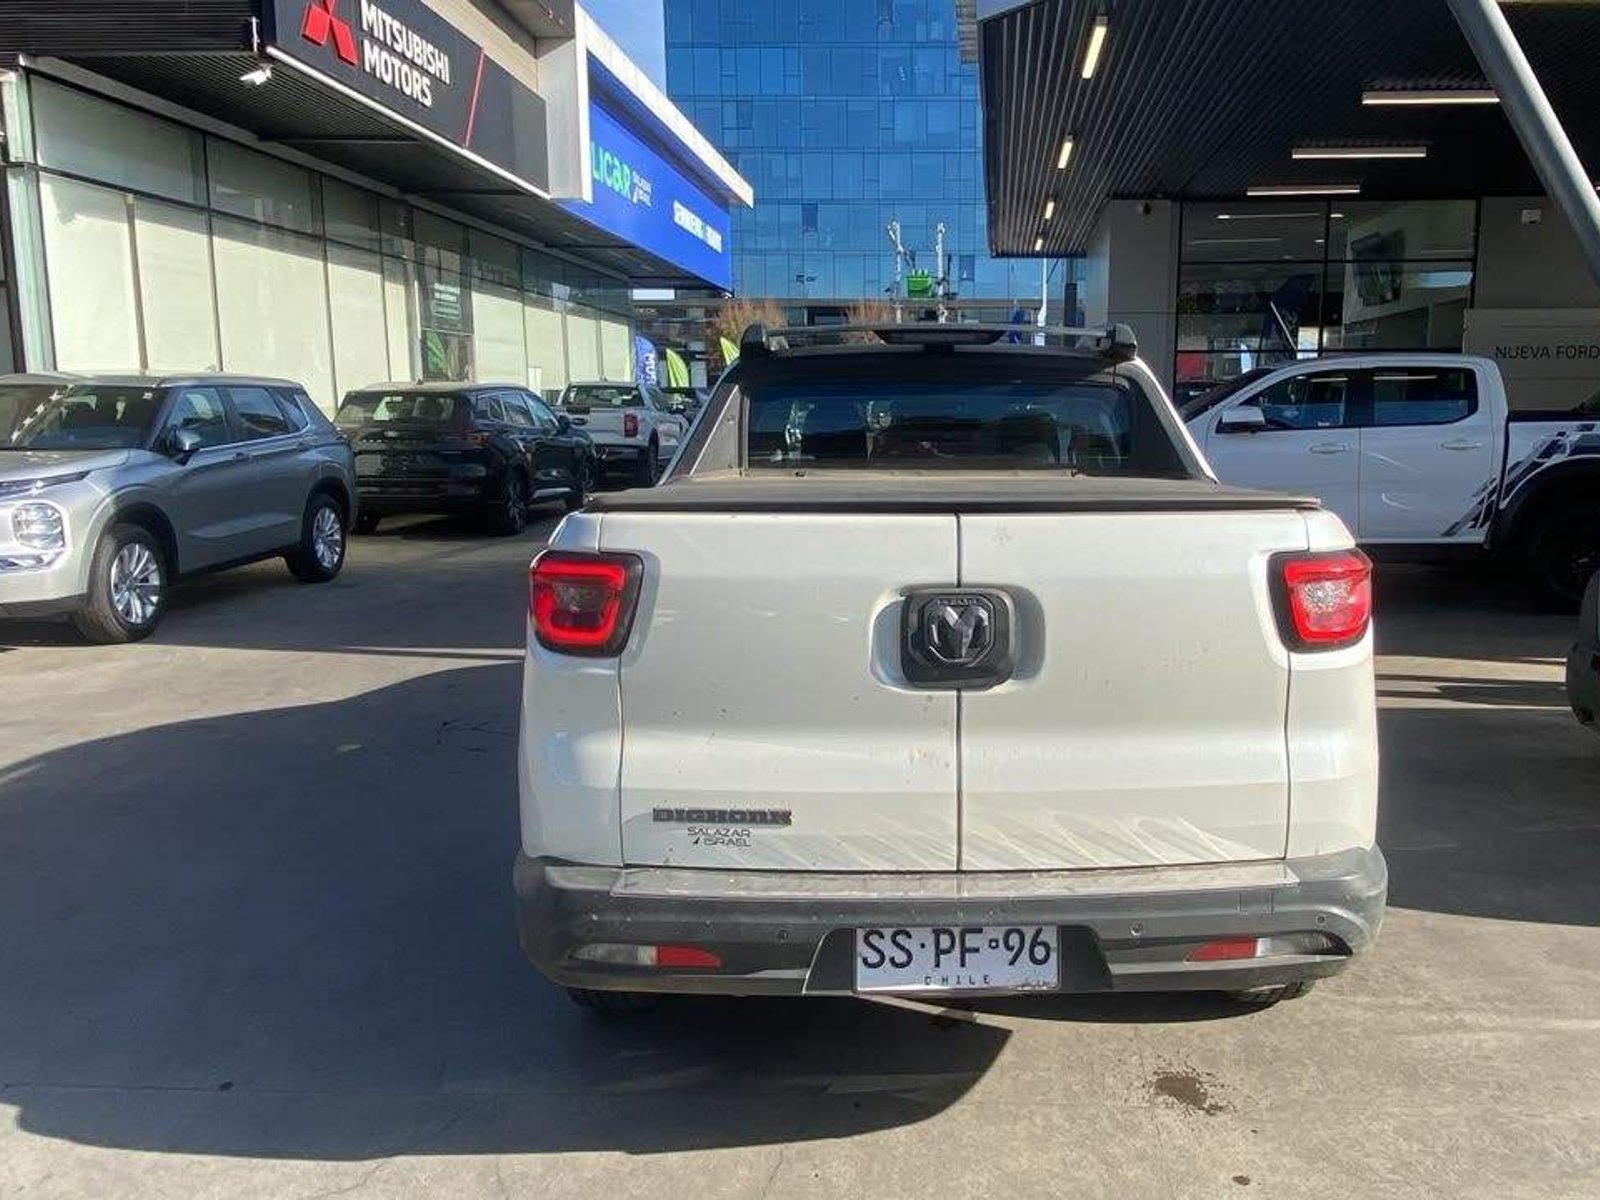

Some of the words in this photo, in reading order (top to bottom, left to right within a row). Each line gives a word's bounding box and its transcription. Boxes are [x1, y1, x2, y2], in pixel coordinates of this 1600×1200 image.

[360, 0, 451, 85] MITSUBISHI
[363, 39, 432, 107] MOTORS
[1495, 345, 1550, 359] NUEVA
[1556, 345, 1600, 359] FORD
[687, 826, 751, 838] SALAZAR
[704, 837, 752, 847] ISRAEL
[924, 974, 991, 986] CHILE
